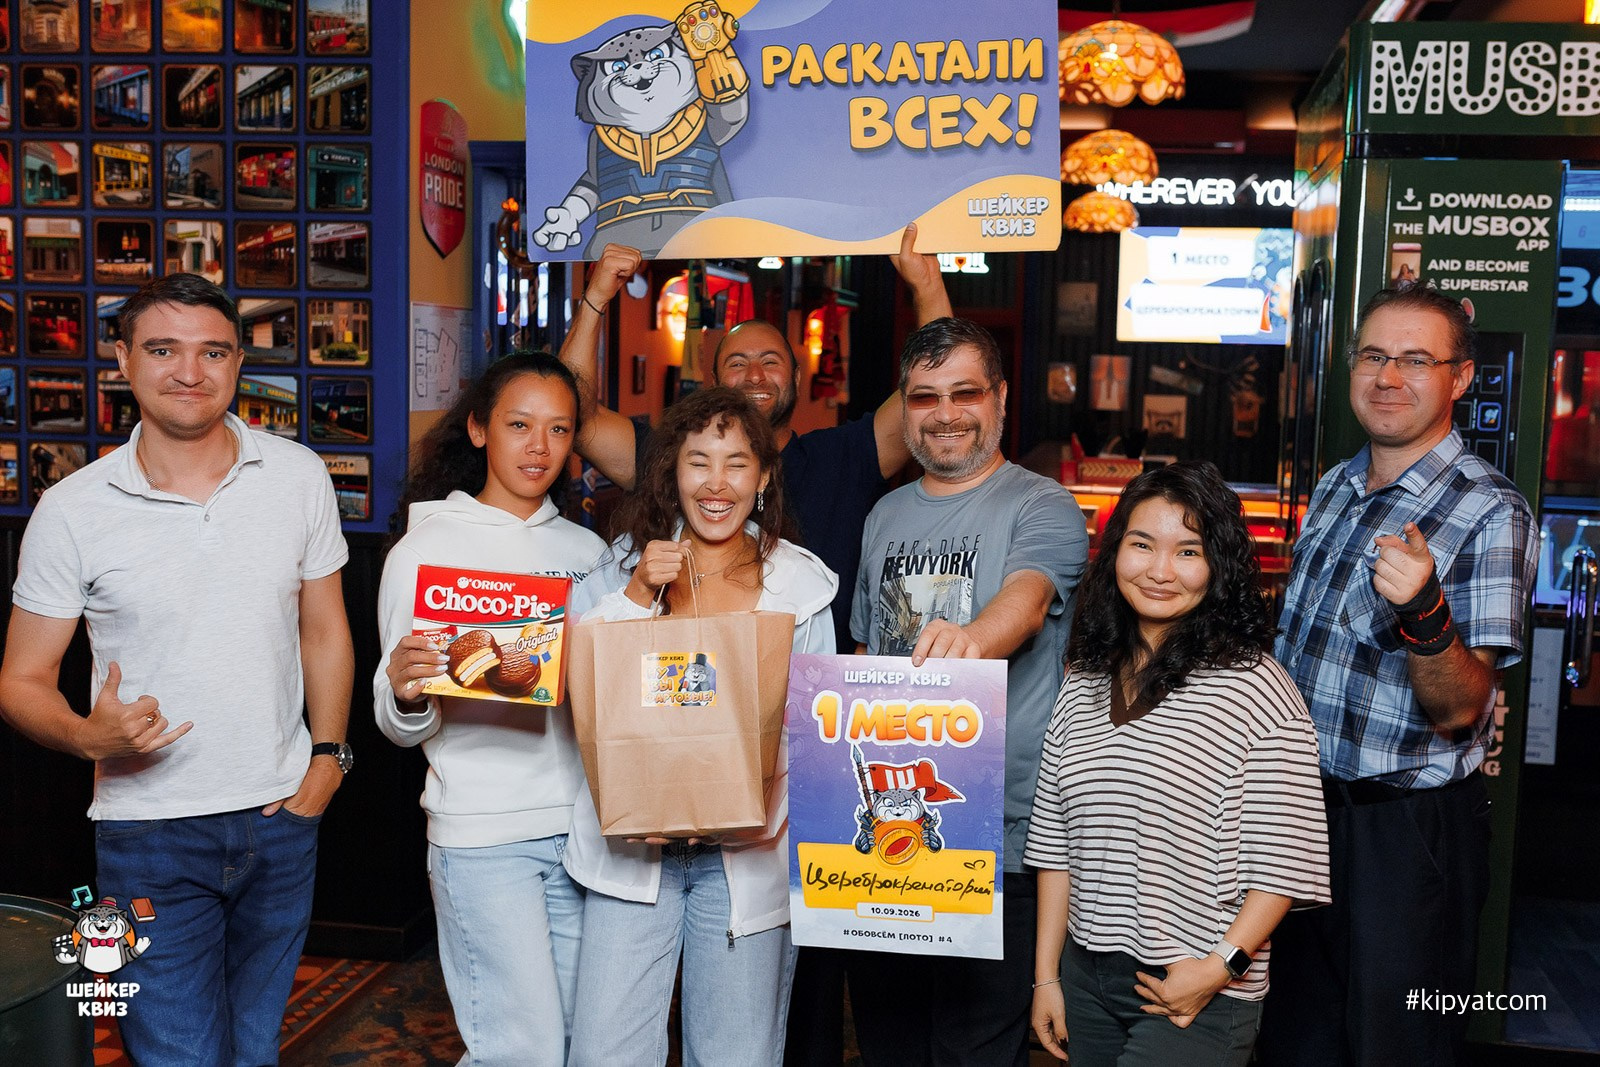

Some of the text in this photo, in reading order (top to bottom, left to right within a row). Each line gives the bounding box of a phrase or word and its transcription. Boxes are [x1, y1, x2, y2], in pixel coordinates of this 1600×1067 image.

[761, 38, 1045, 87] РАСКАТАЛИ
[1368, 40, 1600, 117] MUSB
[849, 93, 1039, 151] ВСЕХ!
[425, 151, 464, 176] LONDON
[425, 172, 464, 209] PRIDE
[968, 193, 1050, 216] ШЕЙКЕР
[1429, 193, 1553, 209] DOWNLOAD
[981, 217, 1036, 236] КВИЗ
[1393, 215, 1550, 237] THE MUSBOX
[1516, 239, 1549, 251] APP
[1172, 253, 1177, 264] 1
[1427, 259, 1529, 273] AND BECOME
[1441, 279, 1528, 292] SUPERSTAR
[885, 534, 981, 556] PARADISE
[471, 579, 513, 592] ORION
[516, 628, 558, 652] Original
[845, 668, 951, 686] ШЕЙКЕР КВИЗ
[816, 695, 979, 742] 1 МЕСТО
[871, 907, 920, 918] 10.09.2026
[899, 932, 933, 943] [ЛОТО]
